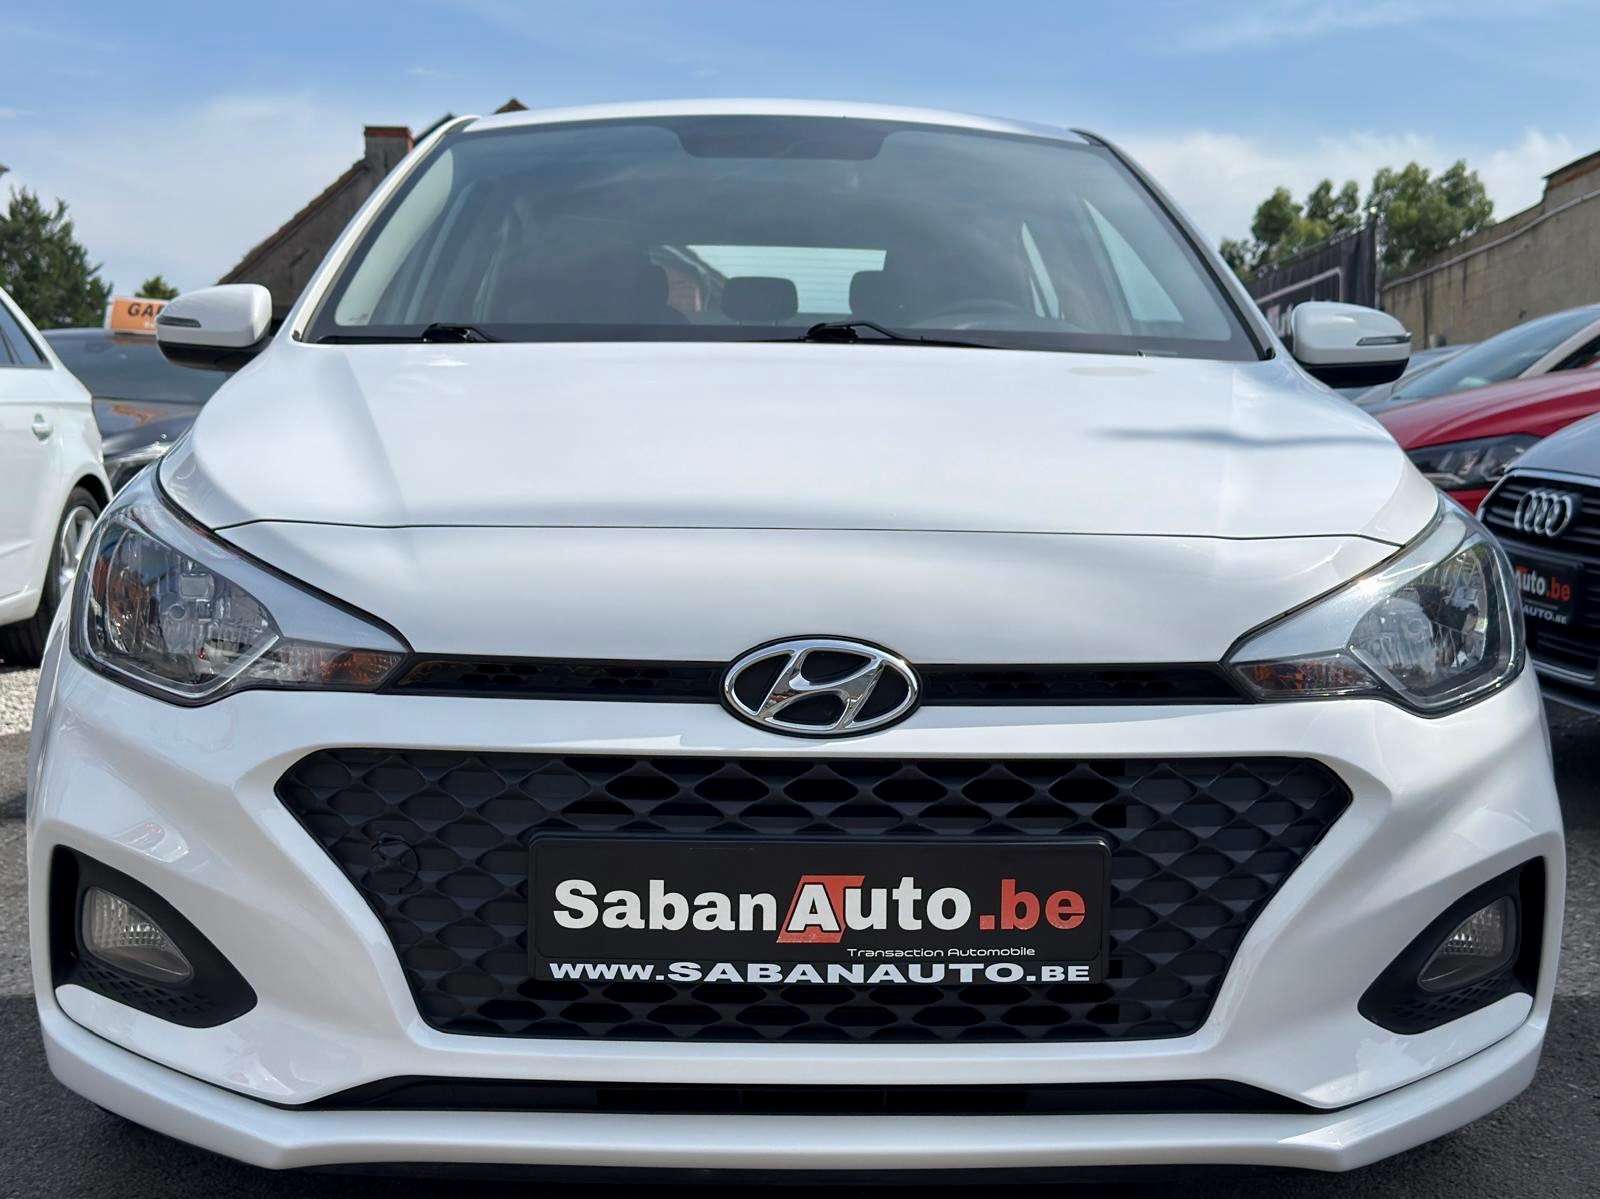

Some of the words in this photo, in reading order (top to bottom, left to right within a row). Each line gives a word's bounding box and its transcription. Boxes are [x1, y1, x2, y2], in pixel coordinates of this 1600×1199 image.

[847, 947, 944, 957] Transaction
[947, 946, 1036, 957] Automobile
[549, 961, 1090, 983] www.SABANAUTO.BE
